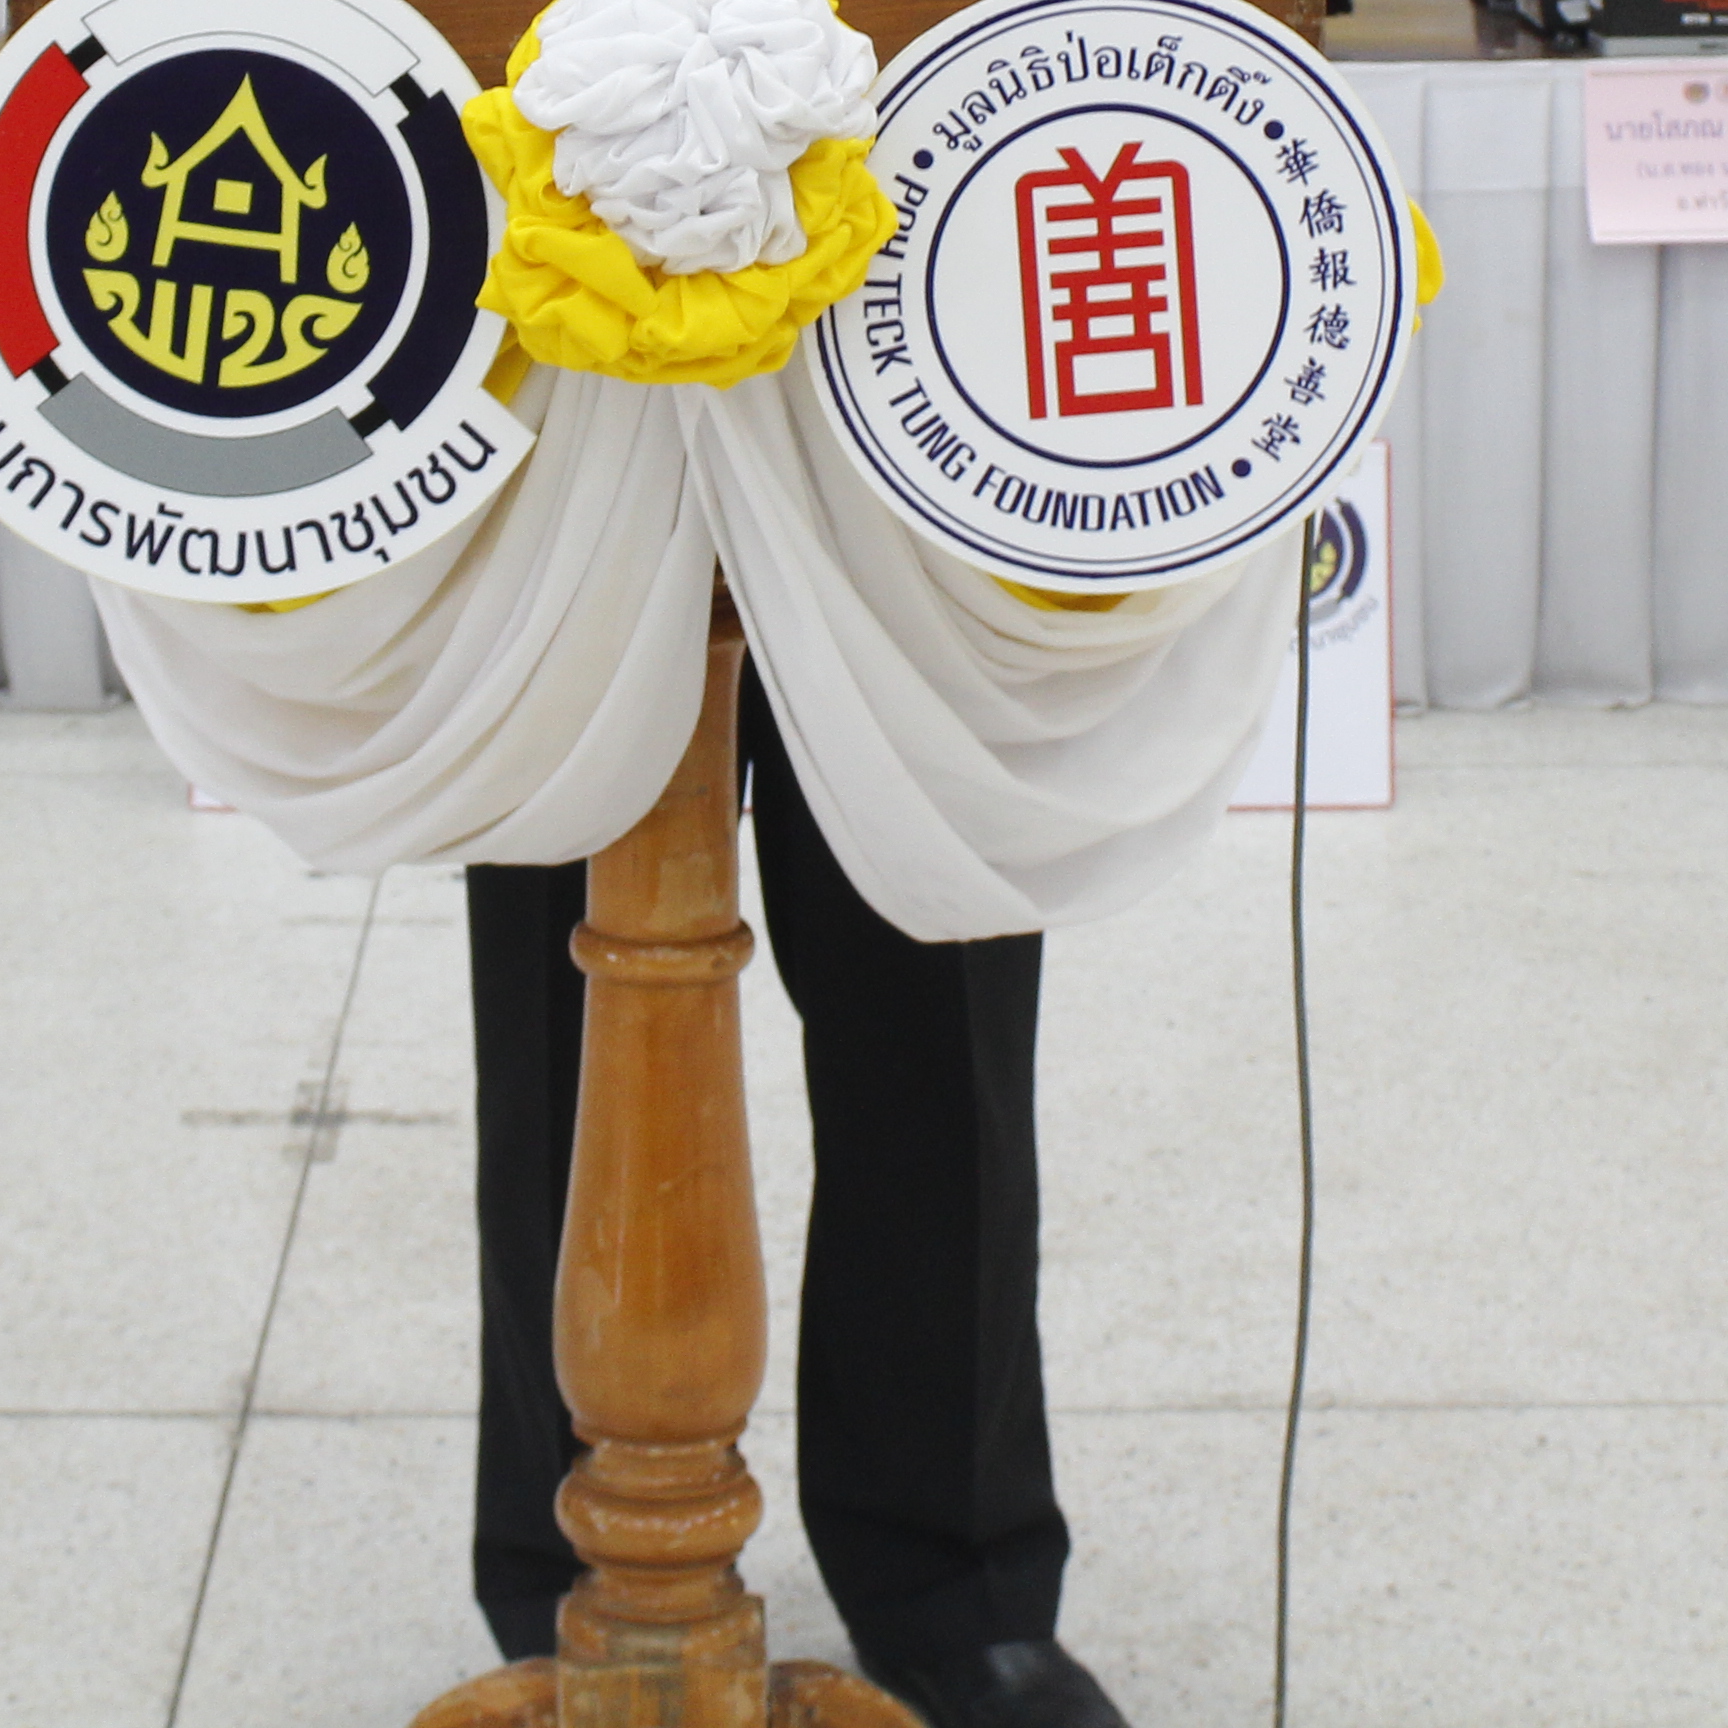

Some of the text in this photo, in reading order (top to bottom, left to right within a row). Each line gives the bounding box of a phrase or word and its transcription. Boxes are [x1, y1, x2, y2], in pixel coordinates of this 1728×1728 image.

[932, 29, 1272, 153] มูลนิธิป่อเต็กตึ๊ง
[863, 272, 914, 376] TECK
[888, 376, 977, 483] TUNG
[972, 463, 1226, 532] FOUNDATION
